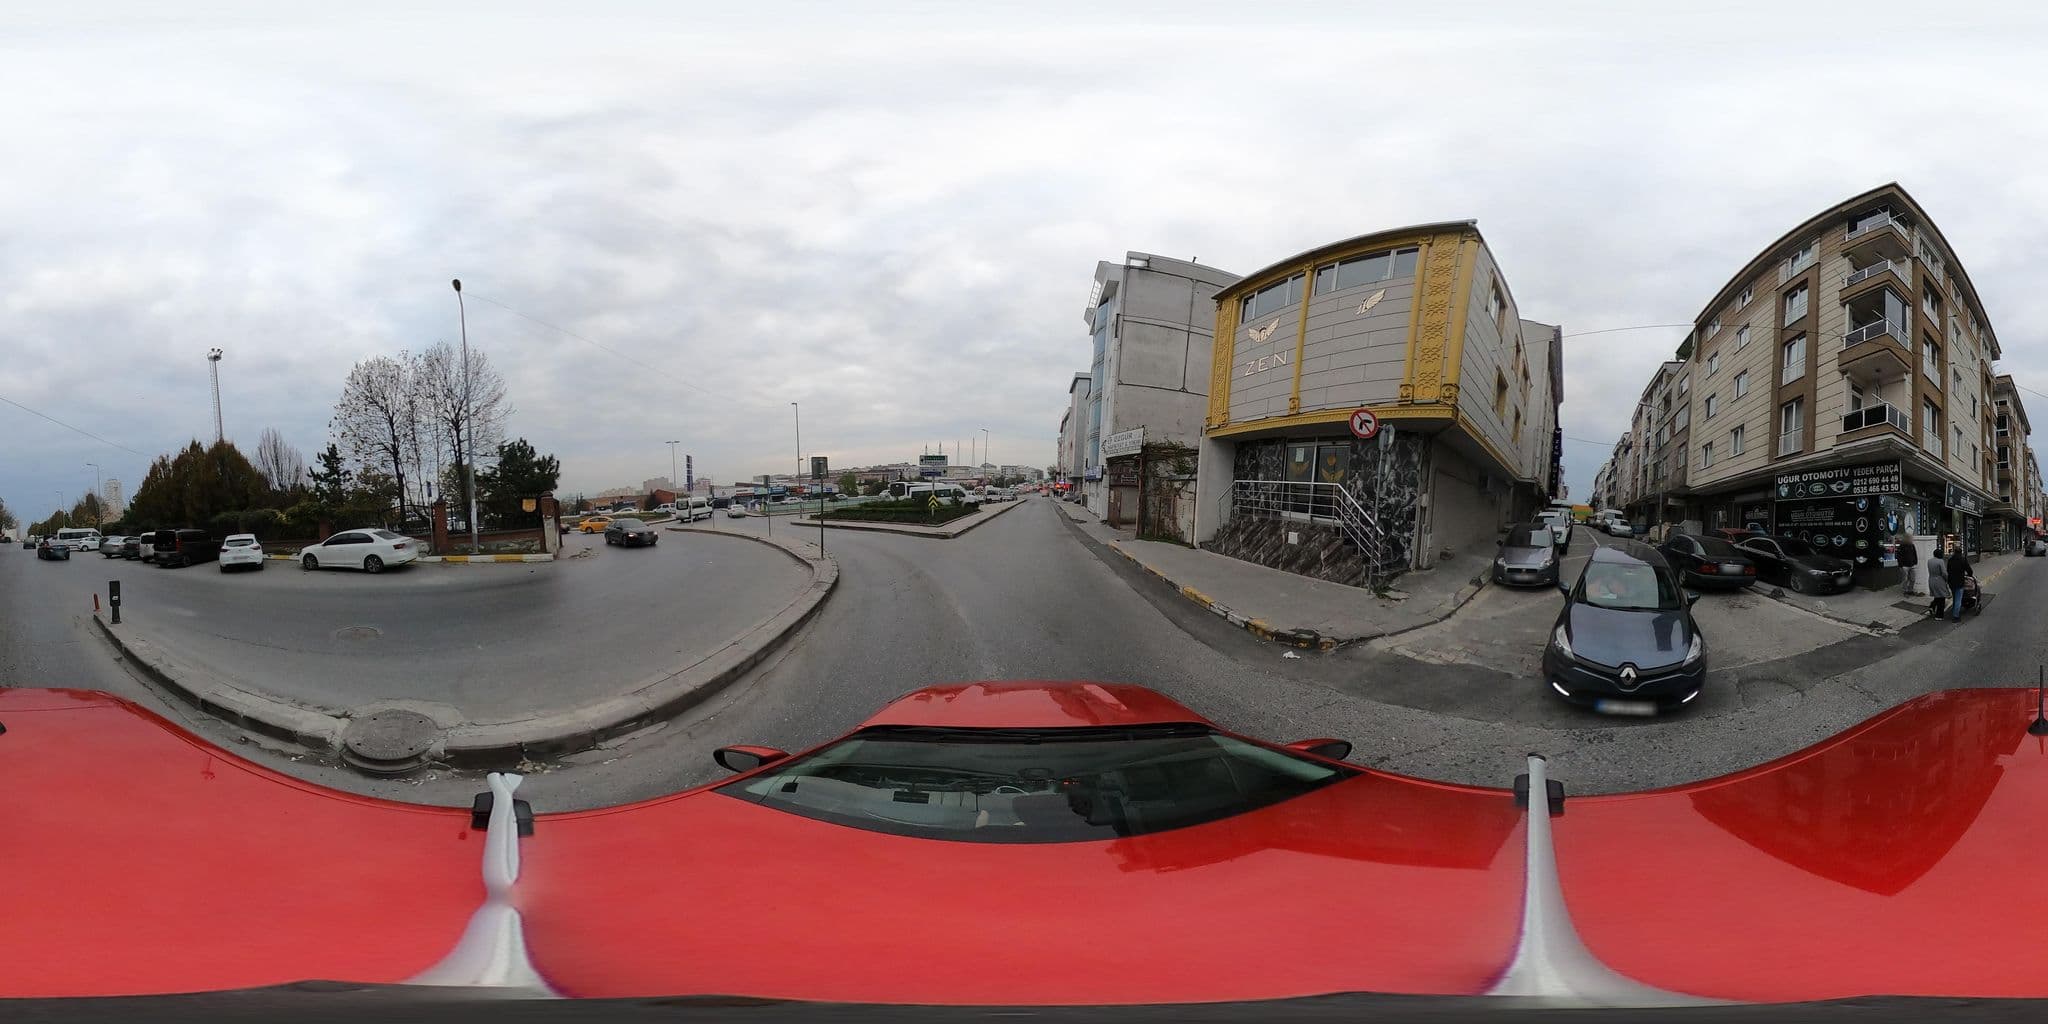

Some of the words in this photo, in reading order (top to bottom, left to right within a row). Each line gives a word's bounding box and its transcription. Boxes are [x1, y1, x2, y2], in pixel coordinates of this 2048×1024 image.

[1245, 350, 1288, 376] ZEN
[1777, 474, 1800, 484] UĞUR
[1802, 467, 1850, 481] OTOMOTİV
[1852, 465, 1875, 477] YEDEK
[1876, 464, 1899, 475] PARÇA
[1853, 477, 1868, 486] 0212
[1881, 475, 1889, 483] 44
[1853, 485, 1868, 494] 0535
[1881, 484, 1889, 492] 43
[1890, 483, 1899, 492] 50
